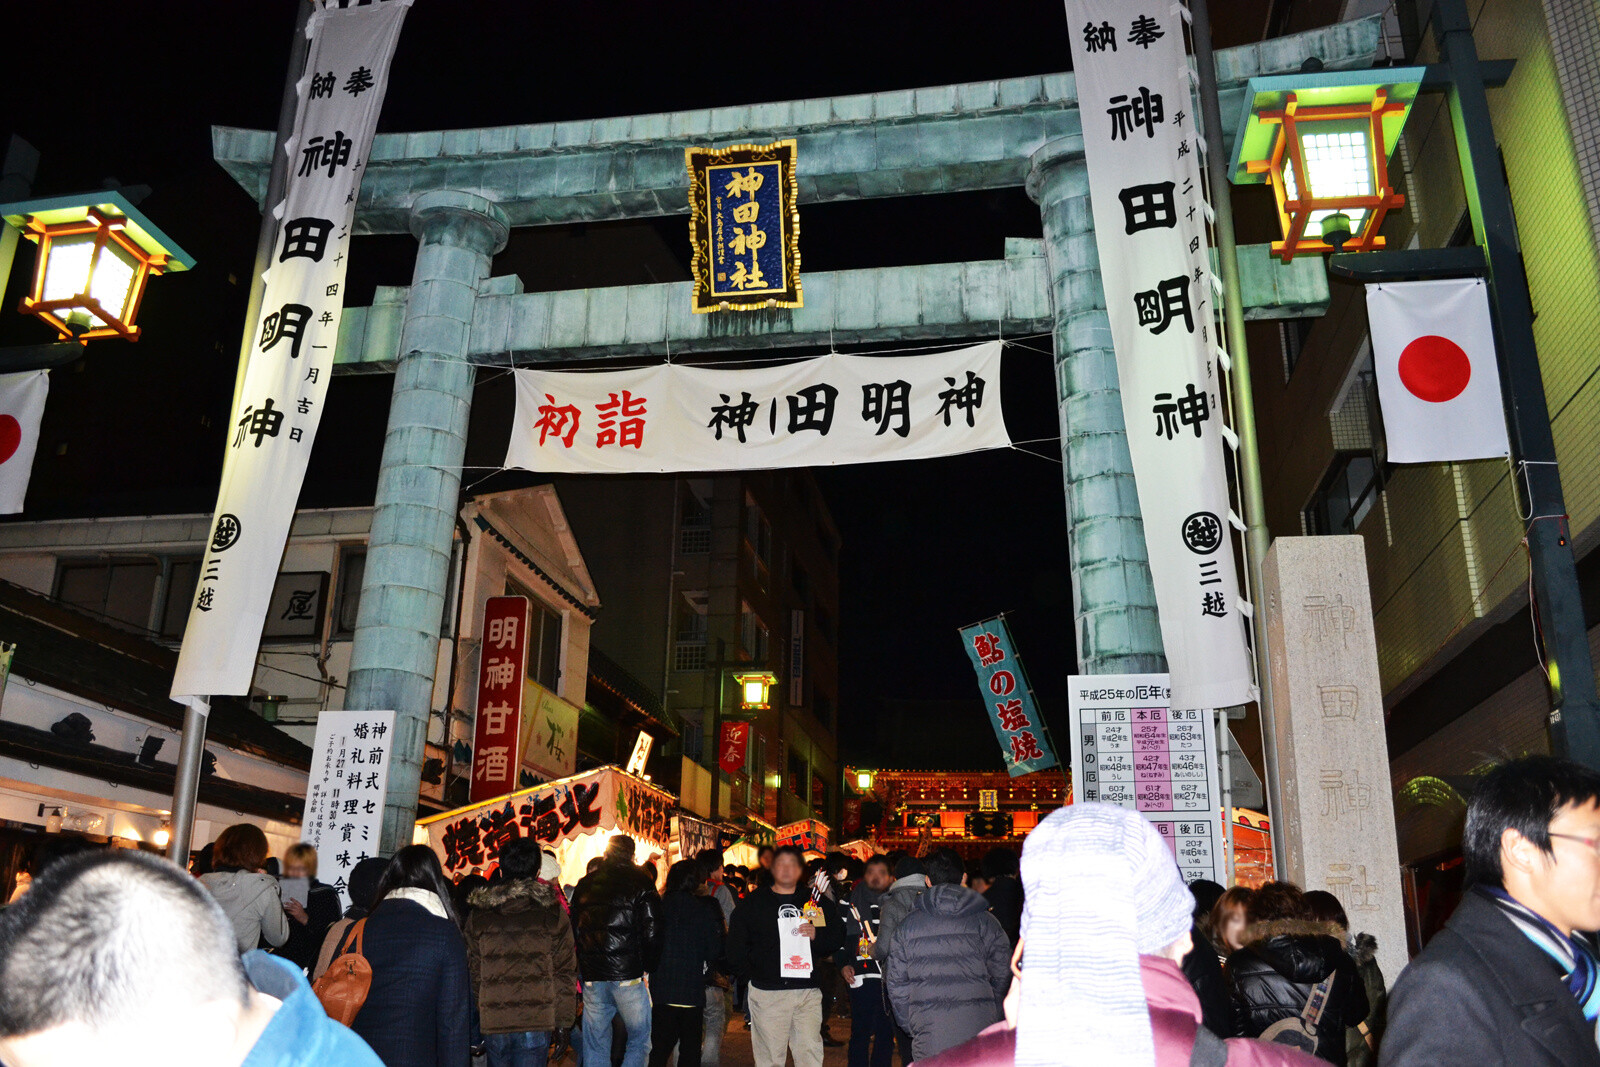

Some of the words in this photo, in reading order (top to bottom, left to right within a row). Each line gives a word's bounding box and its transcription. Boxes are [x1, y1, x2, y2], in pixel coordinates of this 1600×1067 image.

[1083, 14, 1165, 53] 奉納
[309, 66, 375, 101] 奉納
[724, 166, 769, 290] 神田神社
[533, 389, 647, 449] 初詣
[707, 370, 986, 443] 神田明神
[196, 559, 221, 612] 三越
[1198, 560, 1228, 618] 三越
[476, 616, 520, 782] 明神甘酒
[974, 631, 1044, 763] 鮎の塩焼
[1101, 711, 1125, 721] 前厄
[1136, 710, 1161, 720] 本厄
[1172, 709, 1197, 720] 後厄
[723, 727, 742, 763] 迎春
[1084, 735, 1098, 801] 男の厄年
[1180, 824, 1205, 834] 後厄
